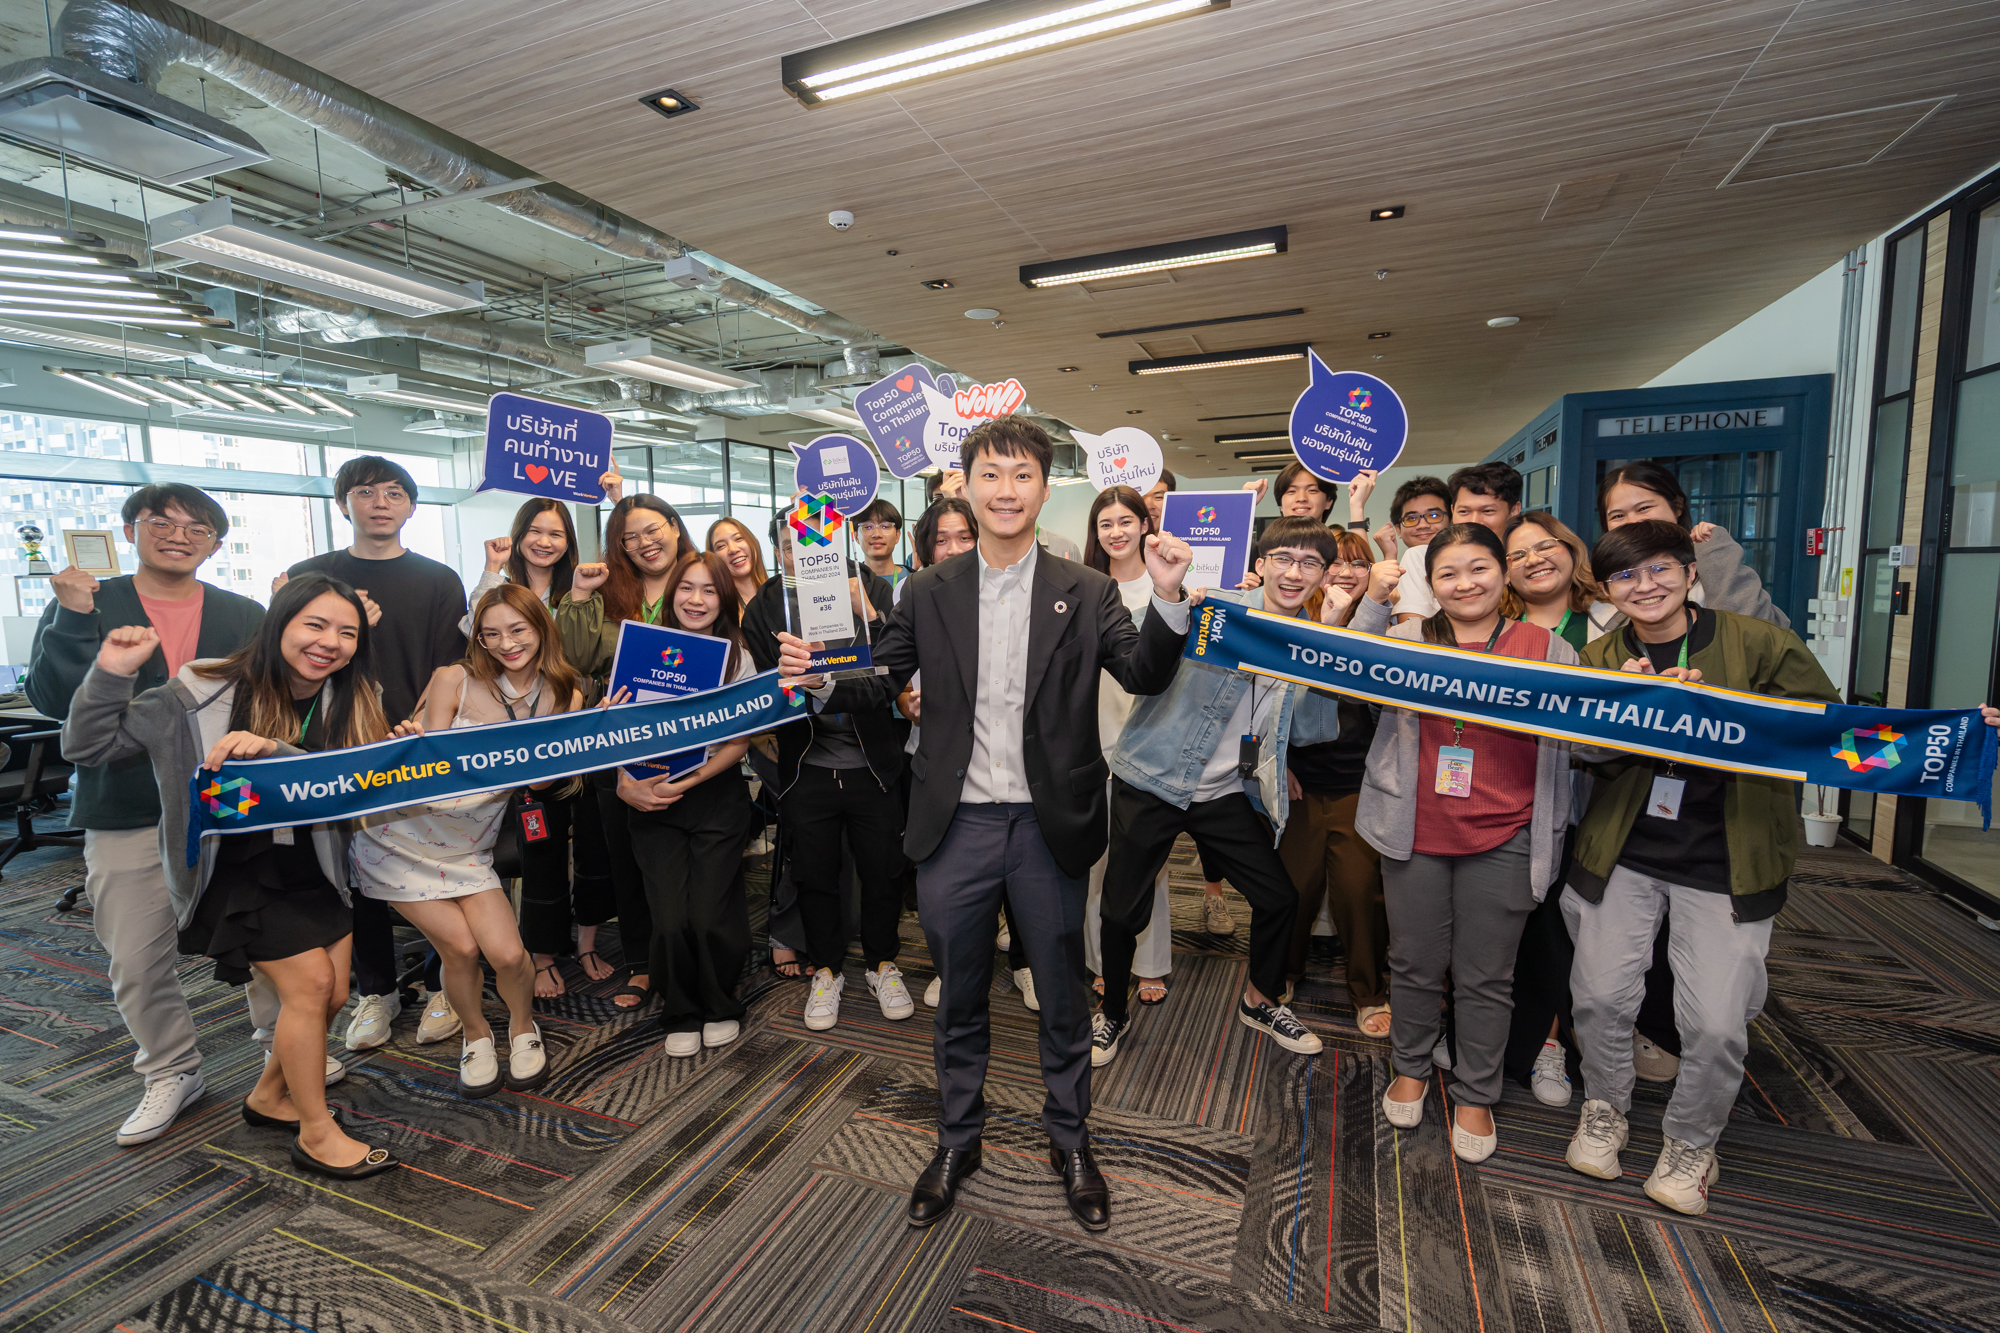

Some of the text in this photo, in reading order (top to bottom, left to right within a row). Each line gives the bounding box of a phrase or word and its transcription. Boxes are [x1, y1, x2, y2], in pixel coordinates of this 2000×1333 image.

[865, 388, 899, 412] Top50
[878, 404, 929, 435] in Thailan
[1339, 406, 1371, 424] TOP50
[1615, 410, 1767, 435] TELEPHONE
[506, 414, 578, 442] บริษัทที่
[938, 422, 977, 441] Top
[1314, 423, 1372, 452] บริษัทในฝัน
[504, 438, 598, 468] คนทำงาน
[897, 447, 921, 463] TOP50
[1097, 444, 1130, 459] บริษัท
[1301, 435, 1375, 468] ของคนรุ่นใหม่
[1099, 461, 1113, 475] ใน
[1103, 462, 1156, 486] คนรุ่นใหม่
[818, 477, 861, 490] บริษัทในฝัน
[1189, 527, 1220, 536] TOP50
[799, 552, 839, 567] TOP50
[801, 566, 833, 575] COMPANIES
[1196, 563, 1219, 571] bitkub
[813, 594, 836, 604] Bitkub
[1195, 606, 1214, 656] Venture
[1210, 609, 1226, 643] Work
[632, 676, 665, 687] COMPANIES
[673, 684, 698, 692] THAILAND
[651, 668, 687, 683] TOP50
[1287, 643, 1746, 745] TOP50 COMPANIES IN THAILAND
[279, 694, 773, 802] WorkVenture TOP50 COMPANIES IN THAILAND
[1920, 724, 1951, 783] TOP50
[1945, 716, 1969, 792] COMPANIES IN THAILAND
